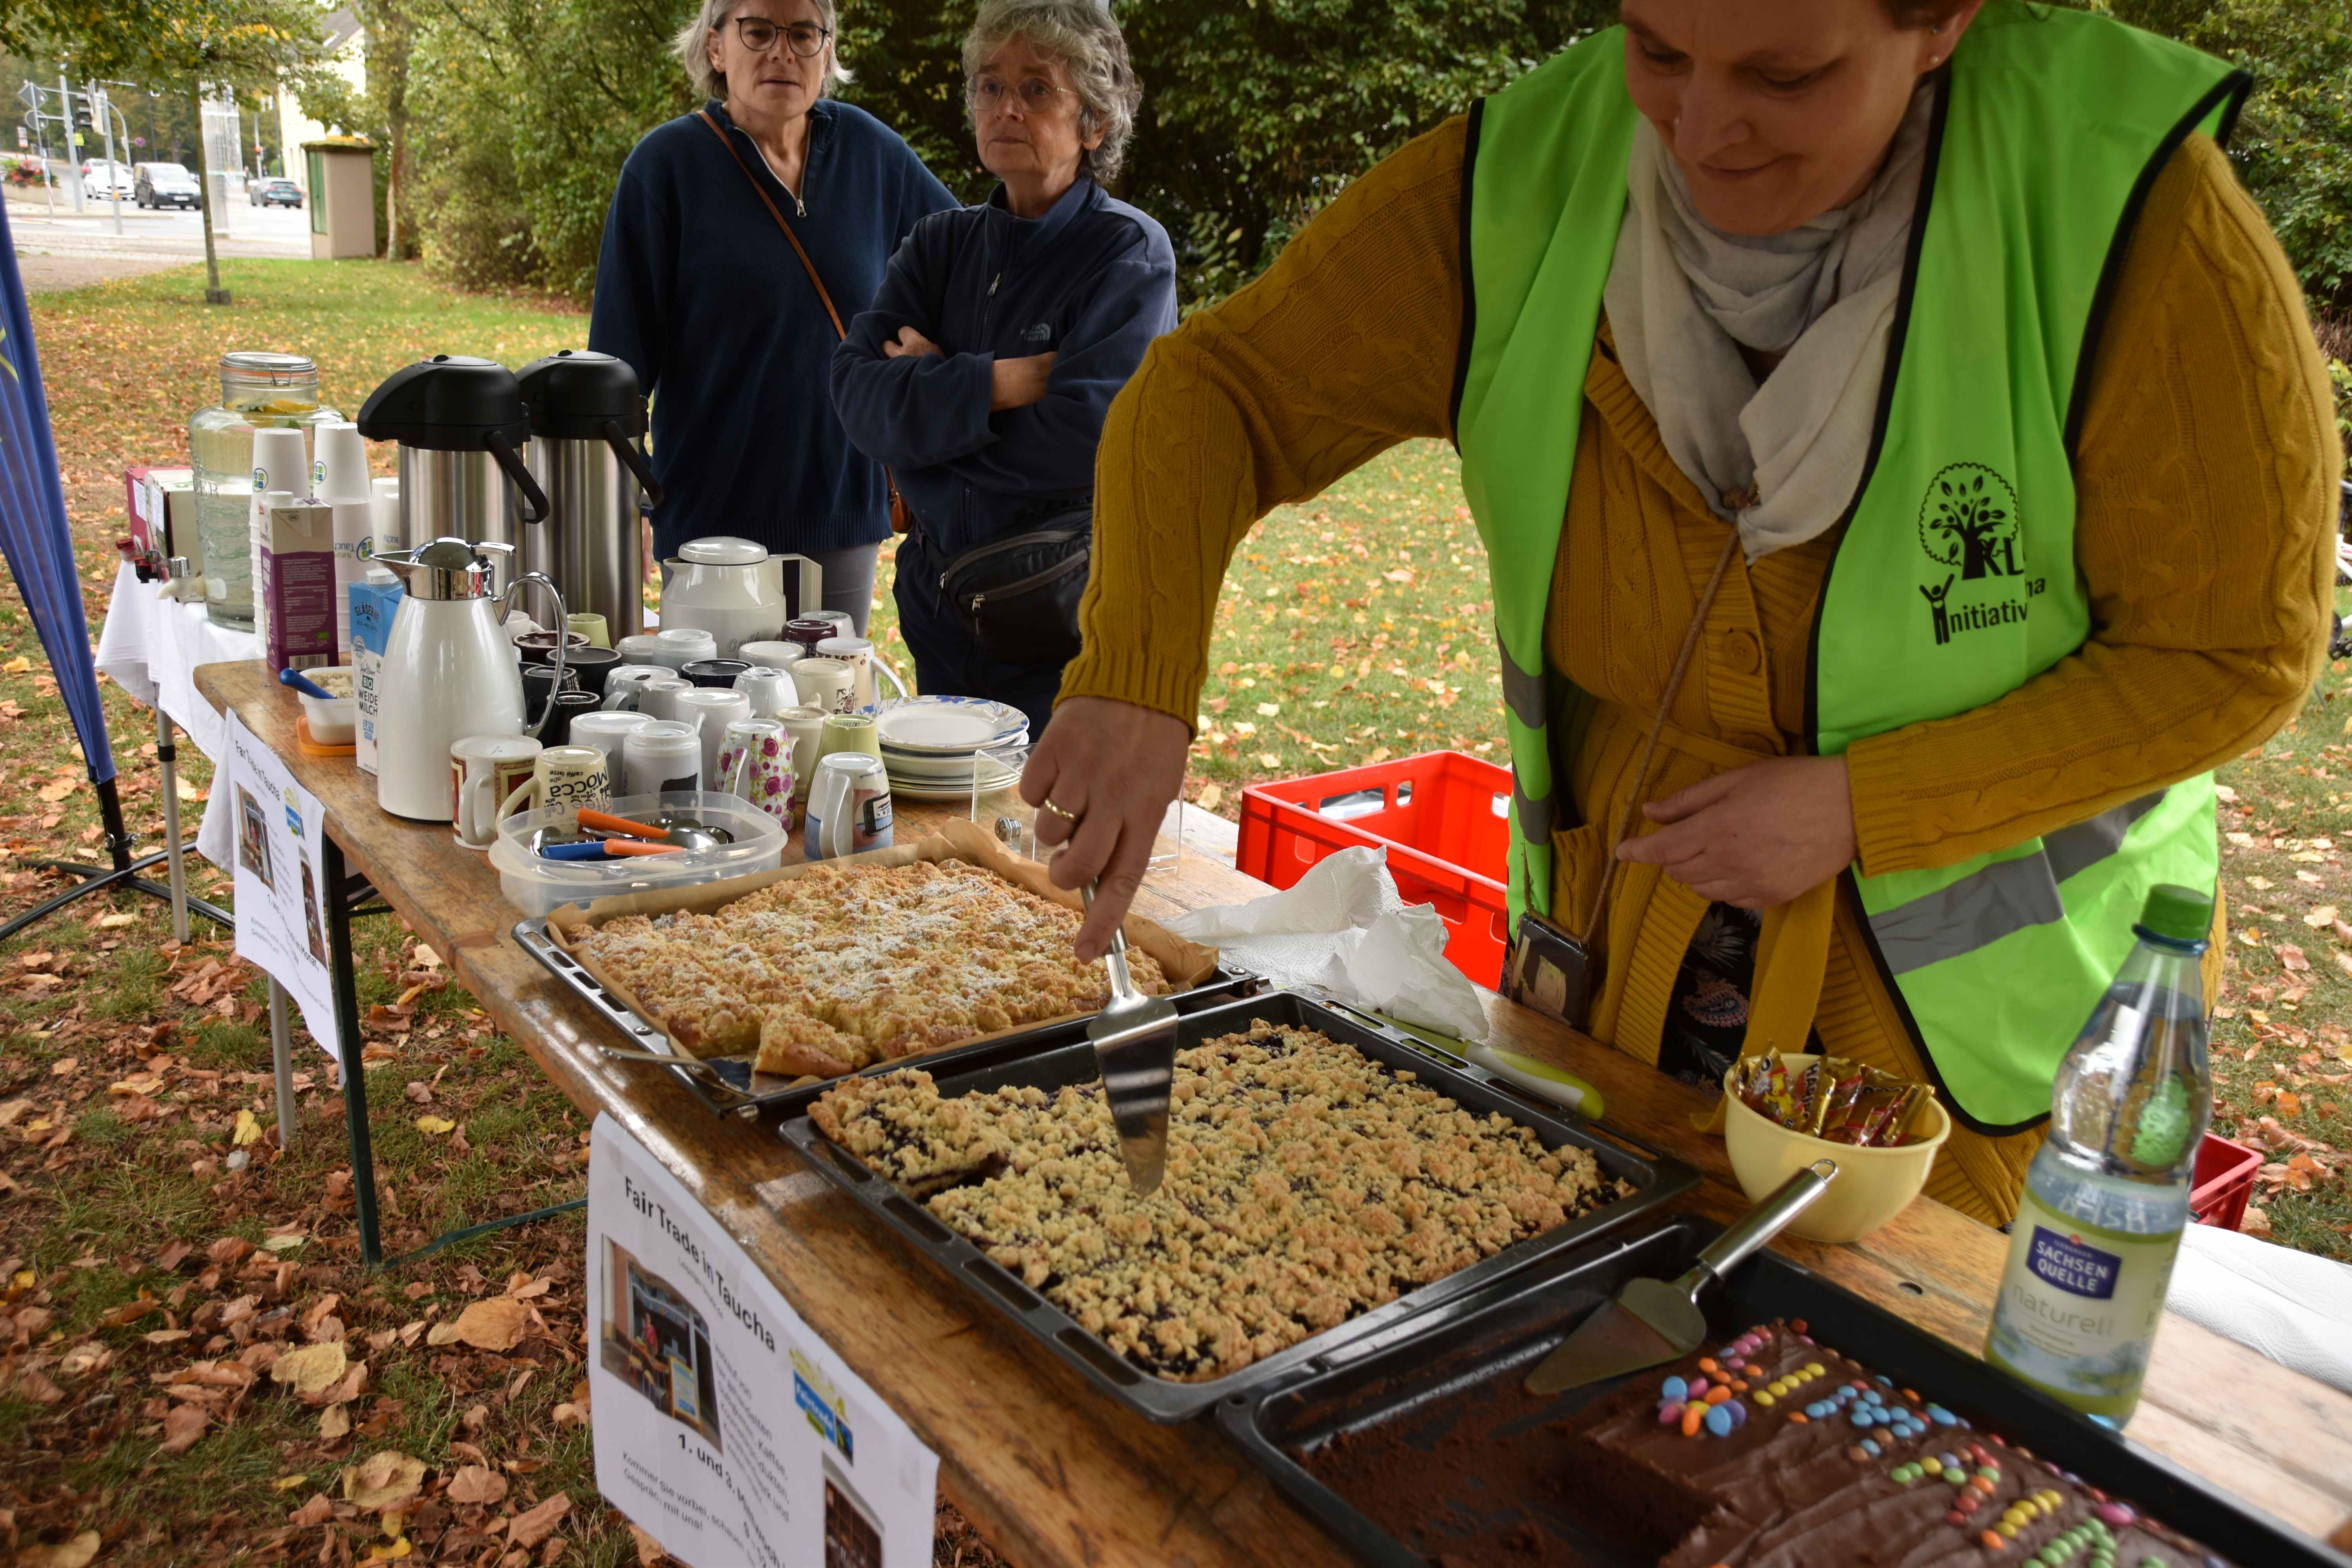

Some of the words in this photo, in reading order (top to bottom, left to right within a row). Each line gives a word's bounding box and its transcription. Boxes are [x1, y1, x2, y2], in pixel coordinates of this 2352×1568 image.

[358, 688, 378, 706] WEIDE
[363, 677, 373, 689] BIO
[359, 701, 378, 717] MILCH
[236, 740, 246, 760] Fair
[262, 769, 280, 802] Taucha
[550, 766, 608, 797] Mocca
[301, 944, 319, 972] Monat,
[625, 1175, 654, 1218] Fair
[657, 1203, 700, 1264] Trade
[702, 1250, 714, 1285] in
[715, 1269, 775, 1353] Taucha
[2036, 1240, 2109, 1279] SACHSEN
[2038, 1258, 2098, 1292] QUELLE
[2013, 1283, 2114, 1339] naturell
[679, 1434, 692, 1454] 1.
[697, 1447, 723, 1479] und
[758, 1437, 788, 1481] Kaffee,
[660, 1480, 675, 1497] Sie
[664, 1501, 679, 1518] mit
[681, 1512, 702, 1531] uns!
